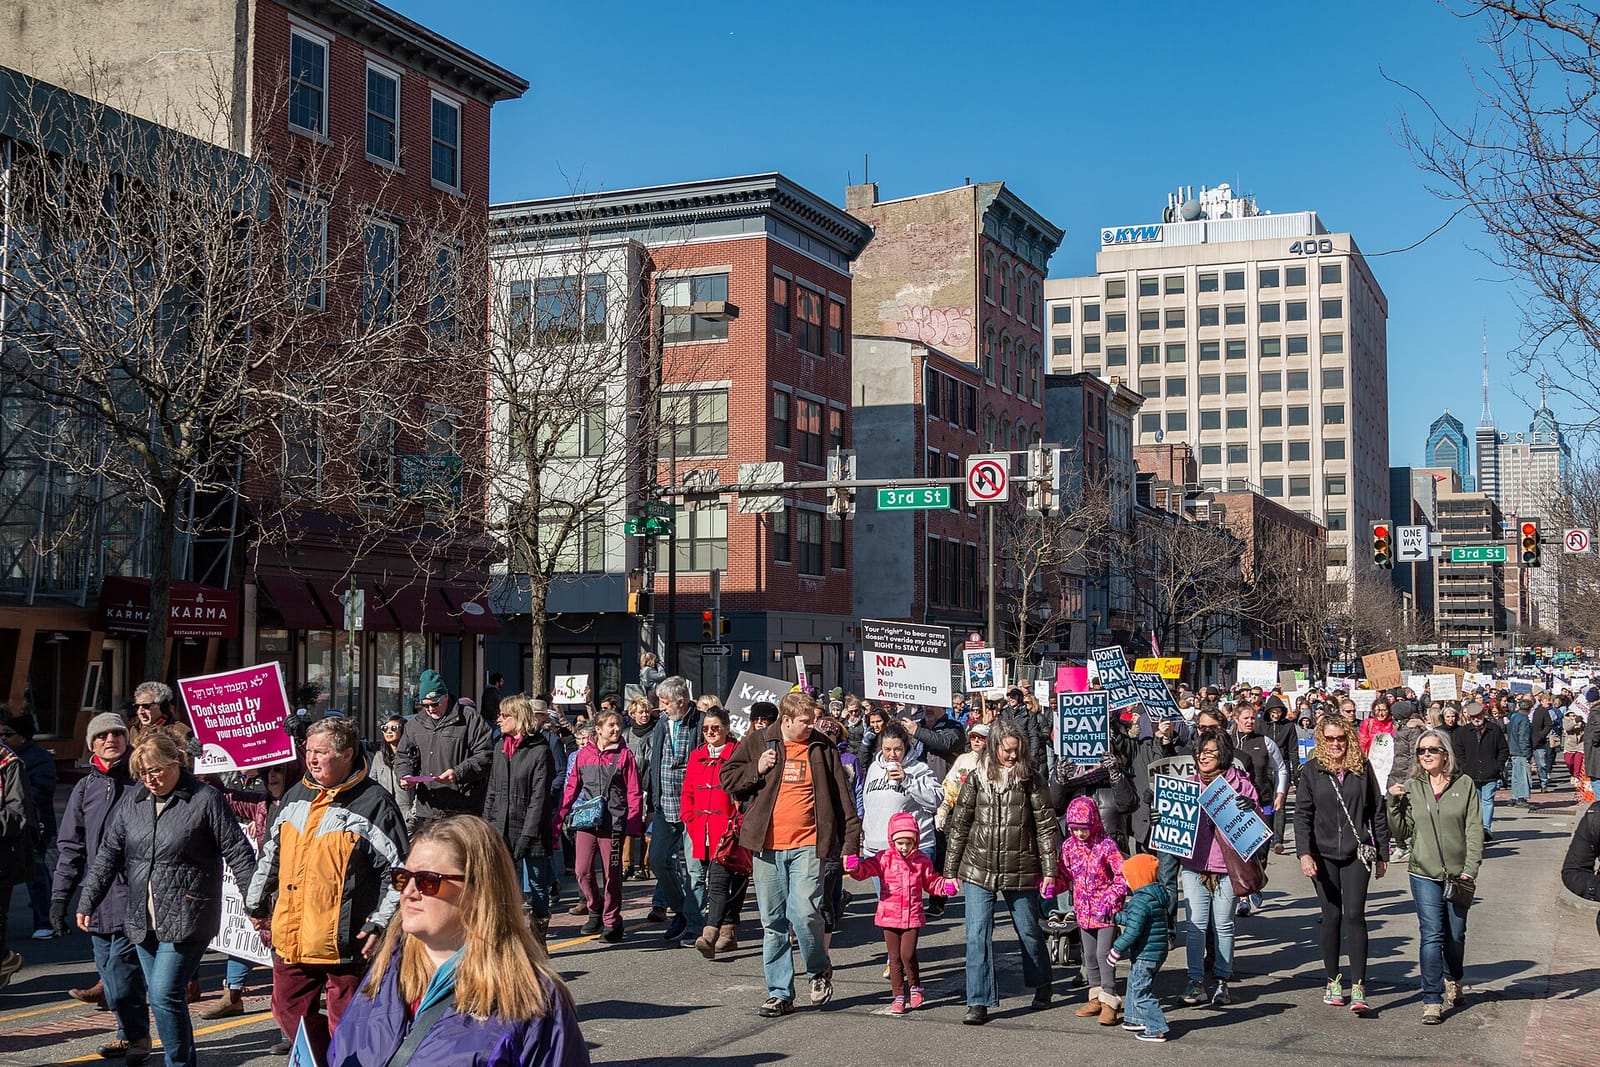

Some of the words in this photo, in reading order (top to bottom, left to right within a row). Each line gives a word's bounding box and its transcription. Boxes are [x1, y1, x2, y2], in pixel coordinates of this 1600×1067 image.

[1115, 226, 1160, 243] KYW
[1289, 238, 1332, 255] 400
[887, 491, 914, 504] 3rd
[924, 490, 941, 503] St
[1403, 529, 1422, 537] ONE
[1459, 549, 1479, 558] 3rd
[1486, 549, 1500, 558] St
[171, 606, 227, 619] KARMA
[1095, 649, 1120, 660] DON'T
[1364, 652, 1396, 668] SAFE
[876, 655, 906, 669] NRA
[1098, 659, 1122, 668] ACCEPT
[877, 668, 894, 677] Not
[1100, 666, 1127, 683] PAY
[566, 675, 576, 700] $
[877, 679, 937, 694] Representing
[1370, 675, 1400, 689] NOW
[739, 682, 778, 703] Kids
[878, 689, 915, 700] America
[1138, 688, 1167, 700] PAY
[192, 703, 218, 717] "Don't
[218, 698, 243, 714] stand
[245, 696, 260, 711] by
[1063, 694, 1105, 706] DON'T
[1064, 706, 1104, 715] ACCEPT
[1146, 705, 1180, 717] NRA
[204, 716, 218, 728] the
[219, 714, 242, 727] blood
[245, 710, 257, 722] of
[1064, 715, 1106, 733] PAY
[216, 730, 231, 741] your
[232, 716, 283, 738] neighbor."
[1063, 742, 1105, 756] NRA
[1149, 764, 1197, 777] NEVE
[1159, 778, 1198, 794] DON'T
[1160, 790, 1196, 804] ACCEPT
[1158, 799, 1197, 821] PAY
[1161, 816, 1179, 826] ROM
[1180, 820, 1195, 831] THE
[1224, 811, 1246, 833] Change
[1233, 817, 1256, 841] Reform
[1155, 825, 1192, 847] NRA
[611, 831, 620, 867] LISTER
[229, 915, 246, 929] FOR
